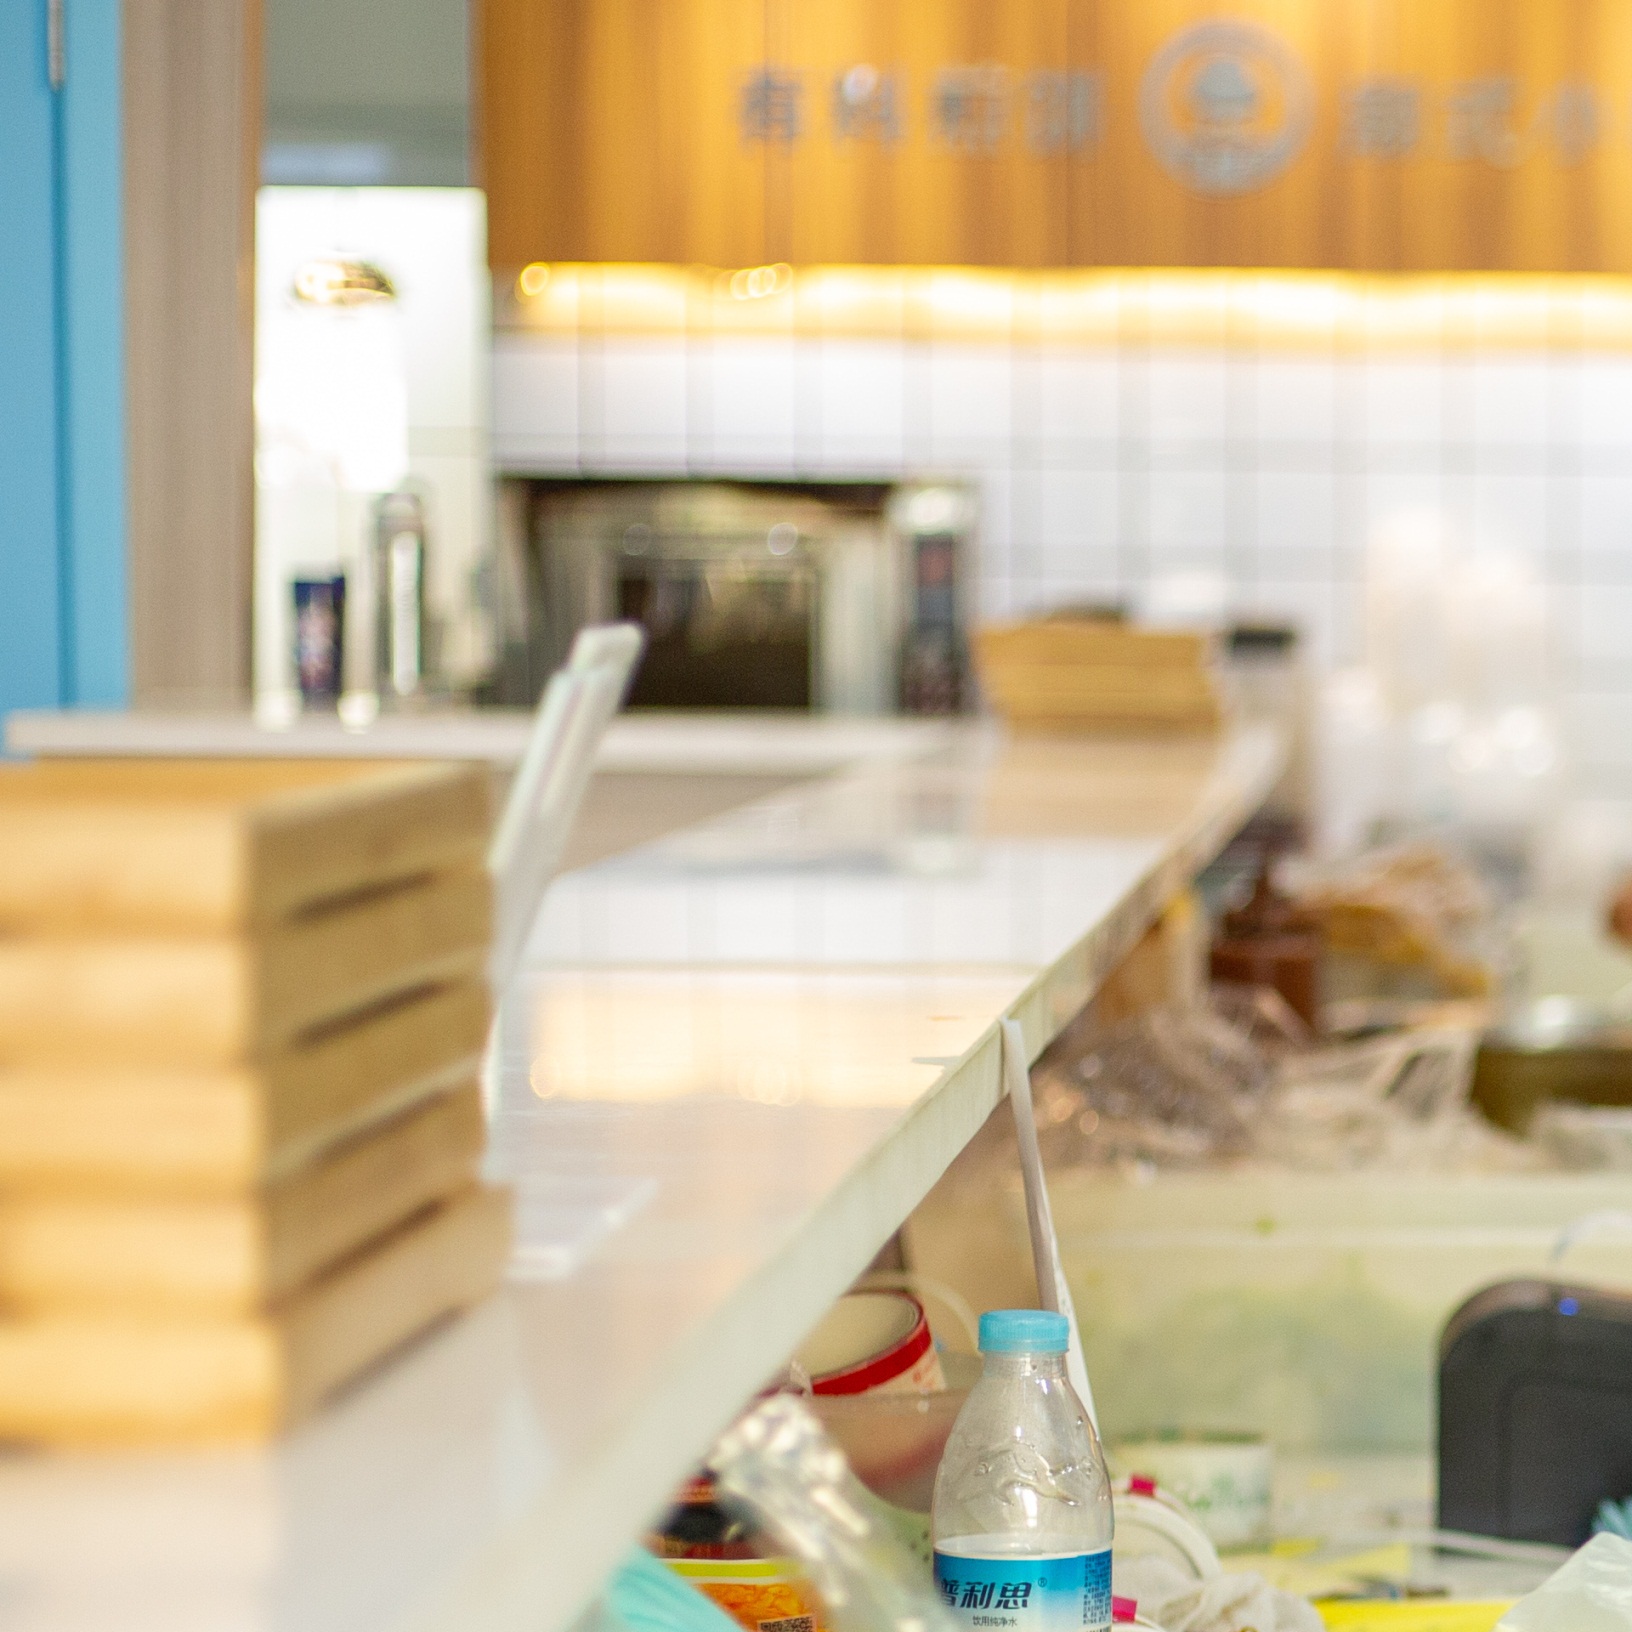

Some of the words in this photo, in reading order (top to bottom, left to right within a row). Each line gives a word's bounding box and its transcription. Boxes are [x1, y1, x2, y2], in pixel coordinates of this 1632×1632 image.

[973, 1615, 1018, 1627] 饮用纯净水
